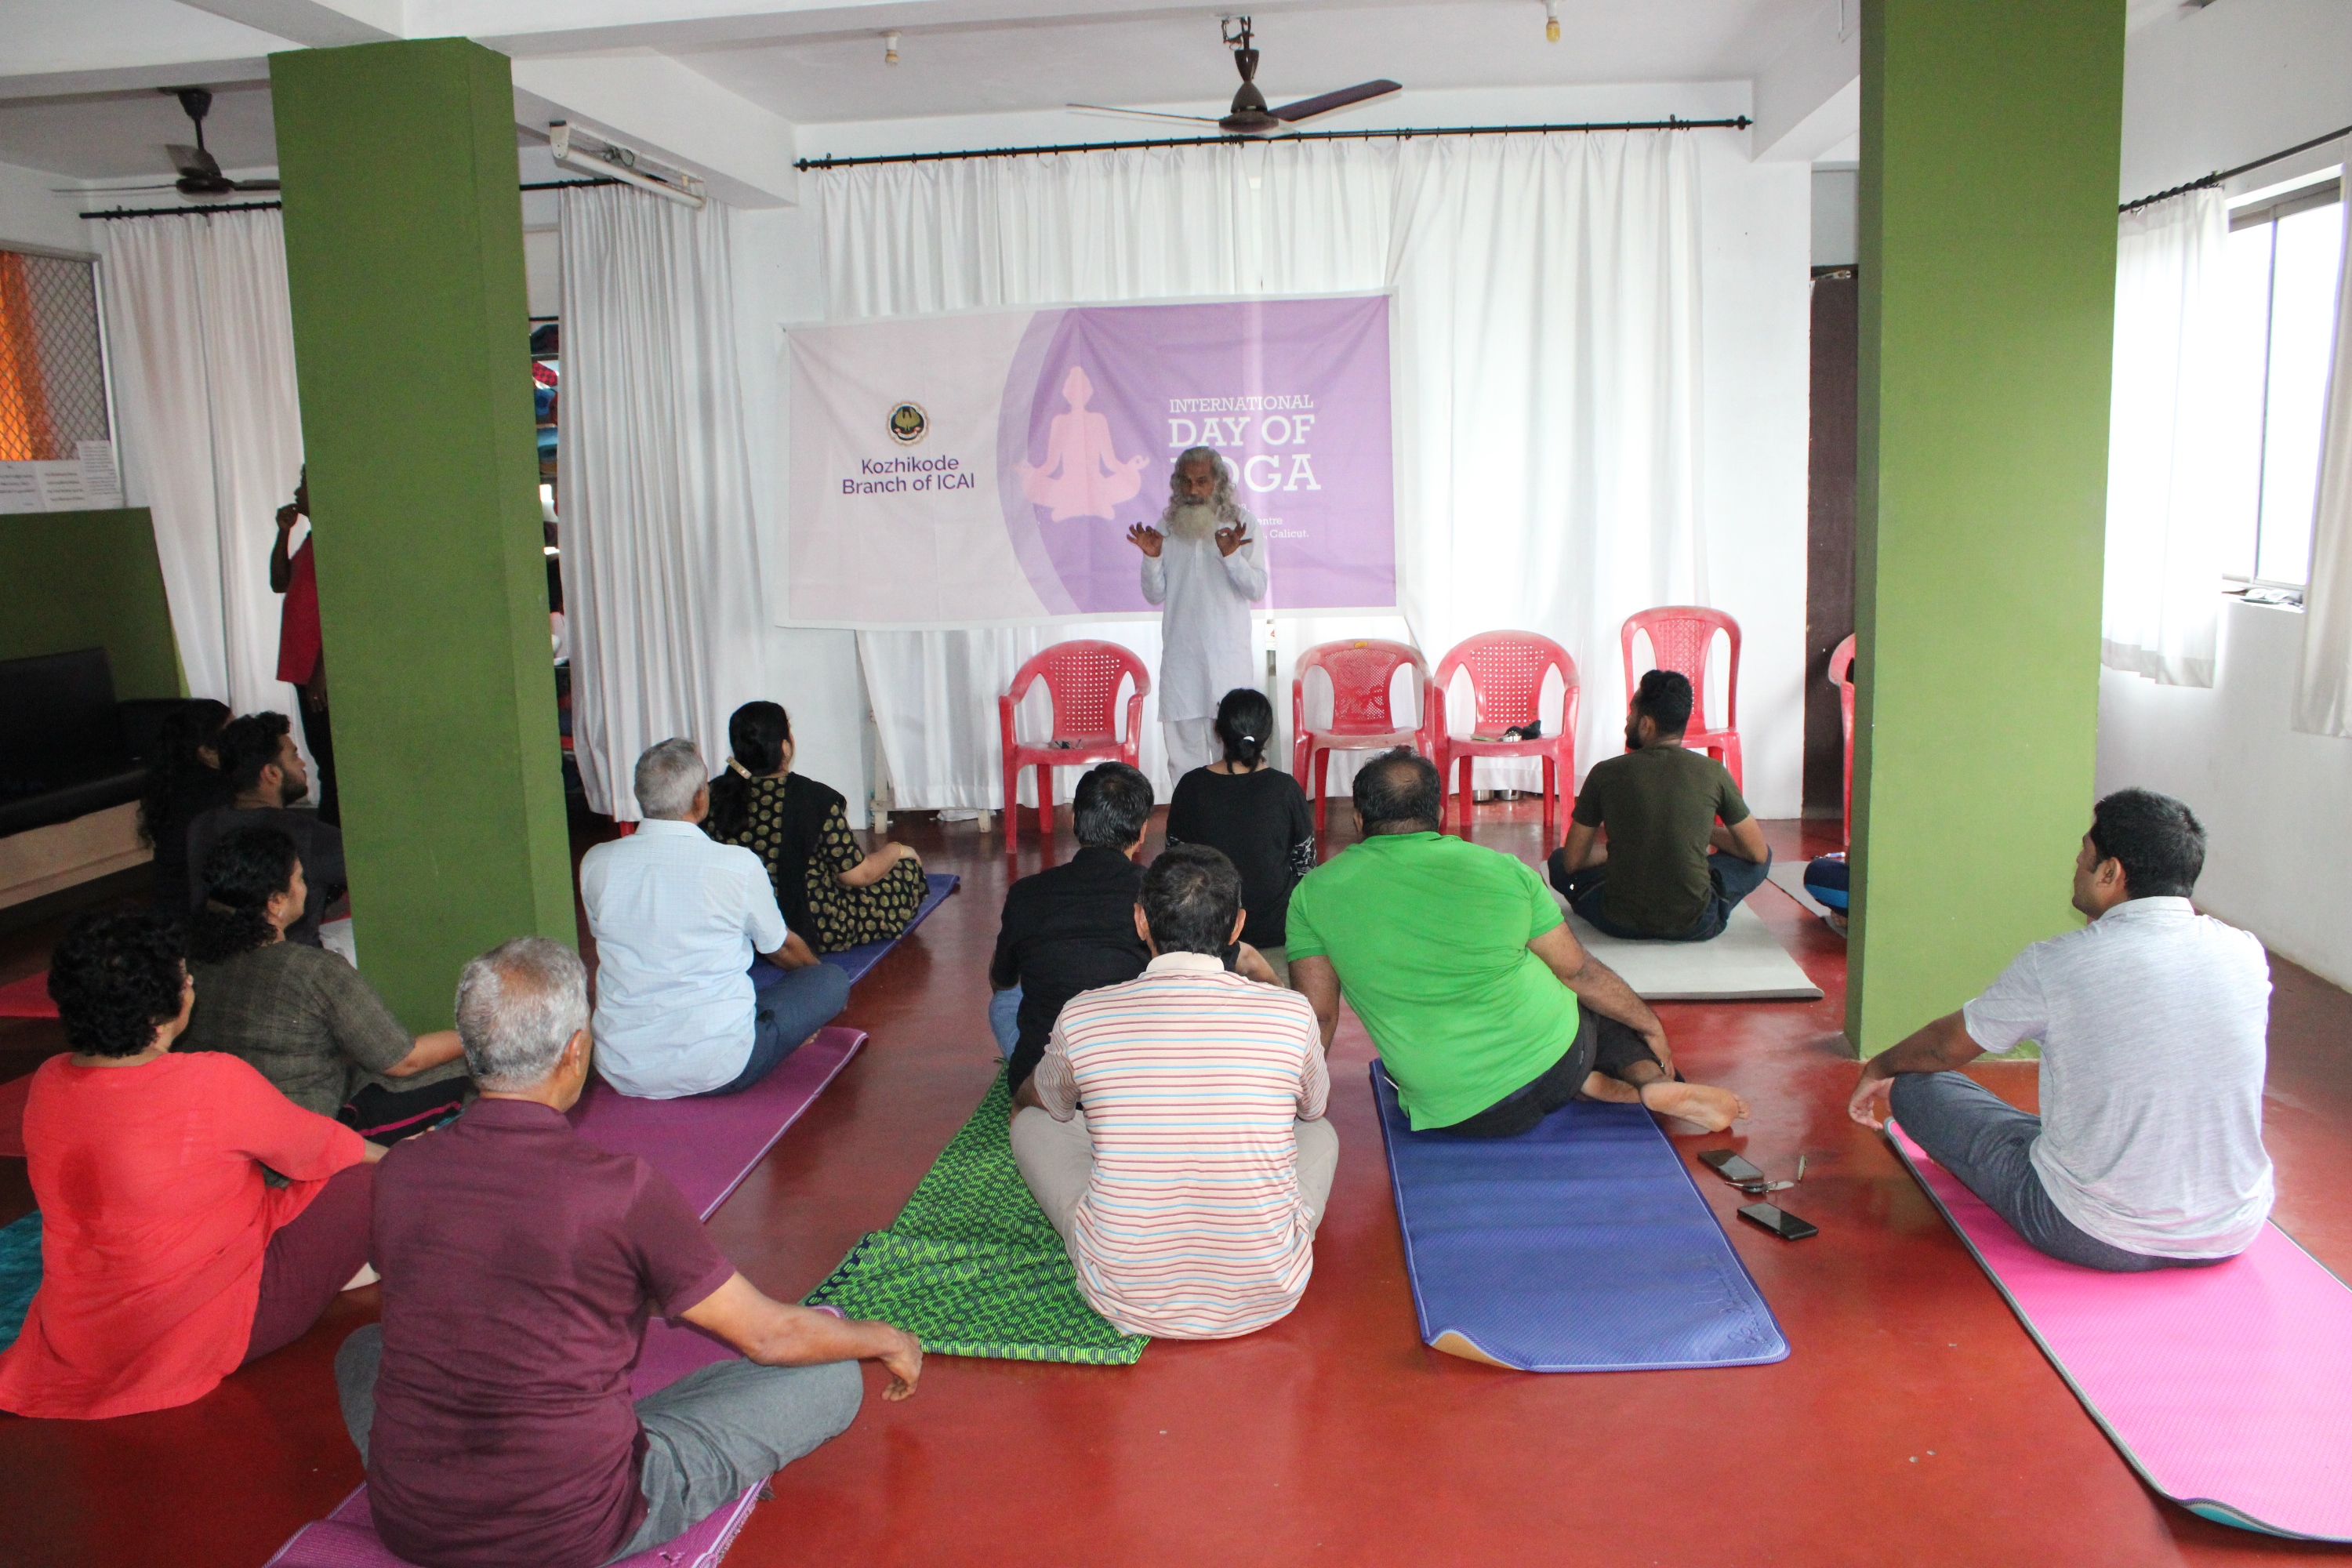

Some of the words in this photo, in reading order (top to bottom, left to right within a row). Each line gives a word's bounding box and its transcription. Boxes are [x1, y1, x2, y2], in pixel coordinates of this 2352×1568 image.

[1169, 394, 1314, 413] INTERNATIONAL
[1168, 416, 1250, 448] DAY
[1261, 414, 1315, 445] OF
[862, 455, 960, 474] Kozhikode
[1170, 453, 1322, 493] GA
[842, 476, 906, 495] Branch
[913, 474, 932, 491] of
[937, 473, 975, 490] ICAI
[1257, 517, 1283, 525] entre
[1269, 528, 1309, 539] Calicut.
